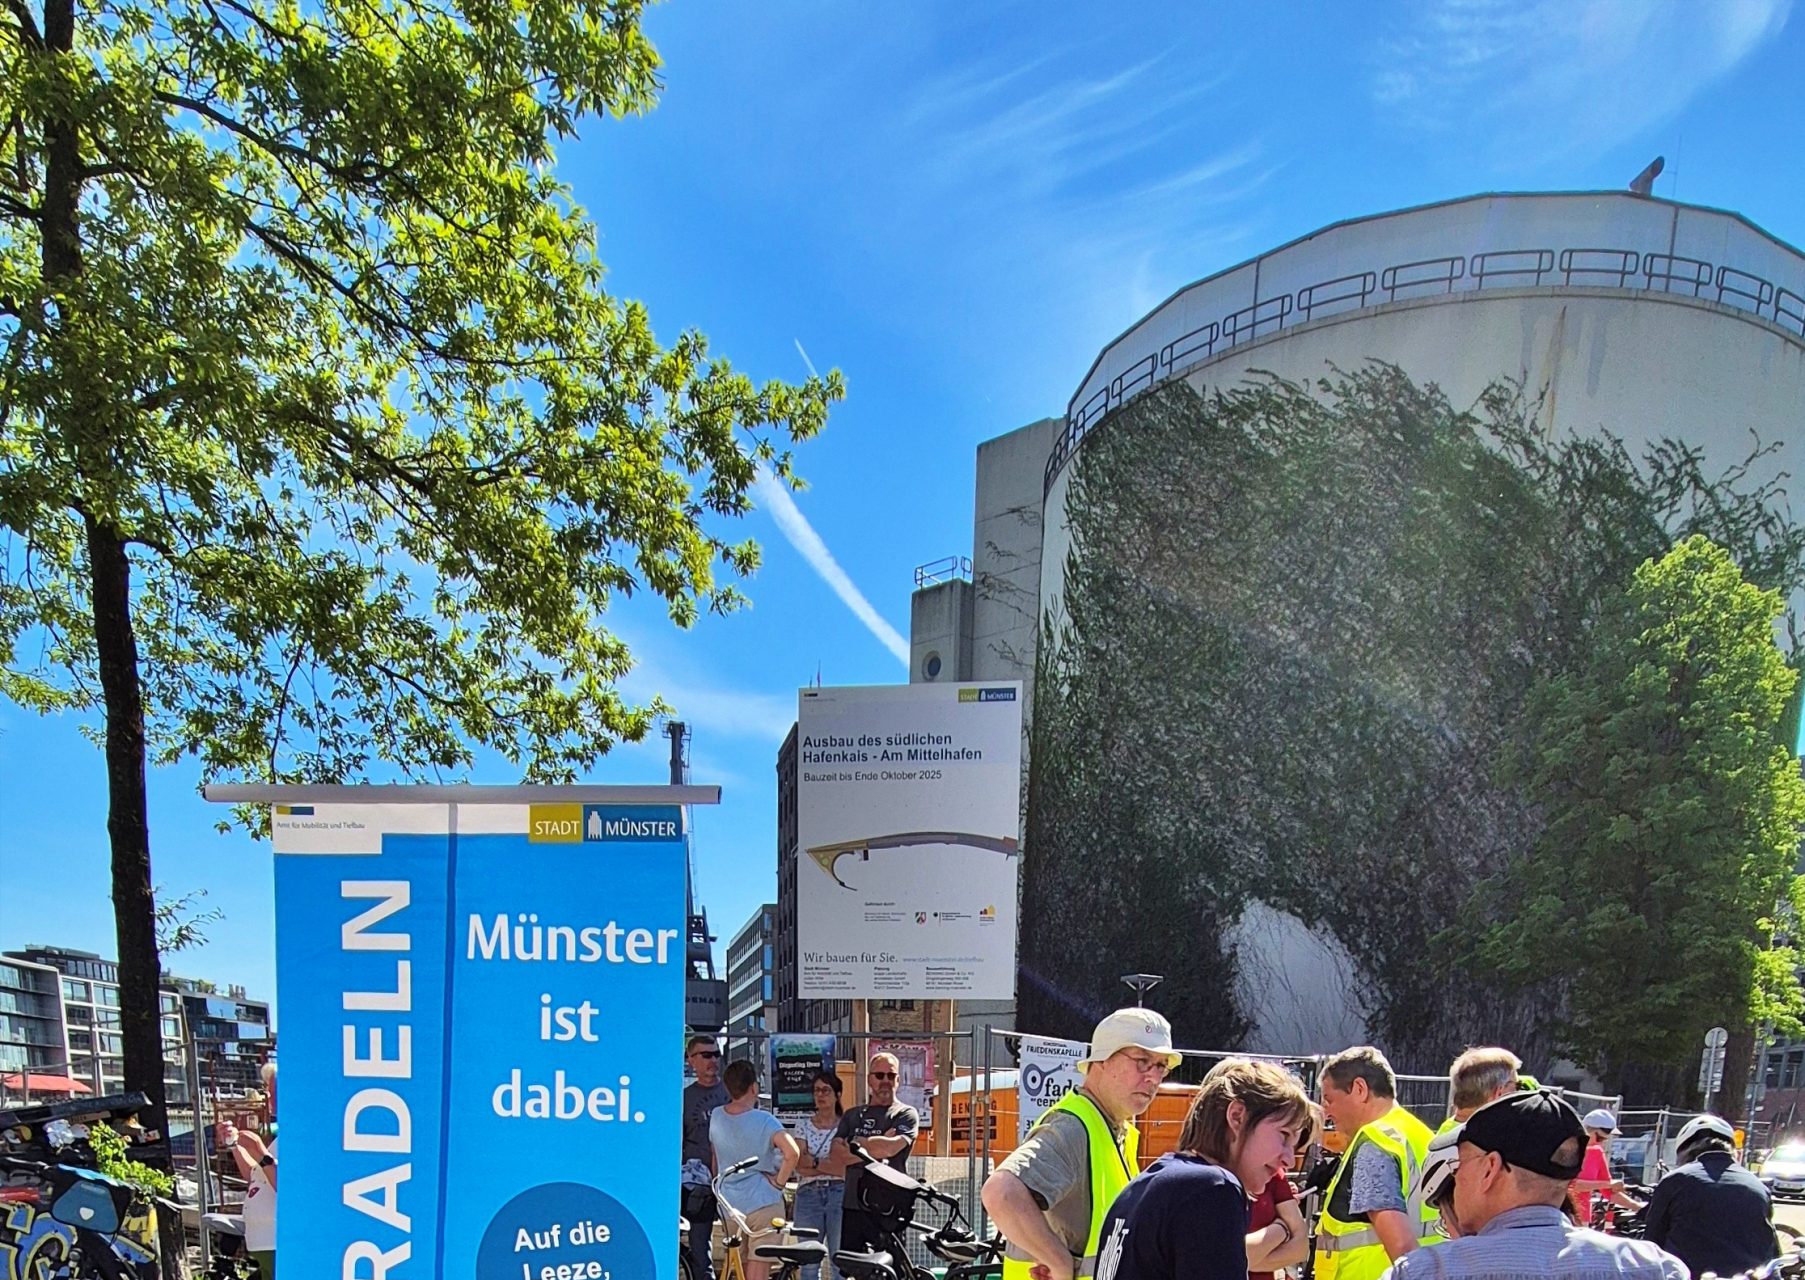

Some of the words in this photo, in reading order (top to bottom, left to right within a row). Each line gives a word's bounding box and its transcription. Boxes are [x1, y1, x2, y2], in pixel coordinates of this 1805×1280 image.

[803, 736, 853, 748] Ausbau
[858, 734, 882, 747] des
[886, 733, 952, 747] südlichen
[803, 751, 868, 763] Hafenkais
[881, 750, 903, 762] Am
[907, 748, 982, 761] Mittelhafen
[804, 772, 837, 782] Bauzeit
[839, 772, 852, 781] bis
[855, 772, 878, 781] Ende
[881, 771, 916, 780] Oktober
[919, 770, 942, 780] 2025
[535, 820, 580, 836] STADT
[605, 818, 676, 836] MÜNSTER
[467, 913, 678, 964] Münster
[804, 952, 823, 963] Wir
[826, 952, 858, 963] bauen
[860, 952, 876, 963] für
[879, 952, 898, 963] Sie.
[540, 993, 599, 1041] ist
[1026, 1045, 1082, 1058] FRIEDENSKAPELLE
[492, 1069, 645, 1123] dabei.
[952, 1100, 997, 1114] BENIG
[514, 1224, 561, 1252] Auf
[569, 1221, 610, 1245] die
